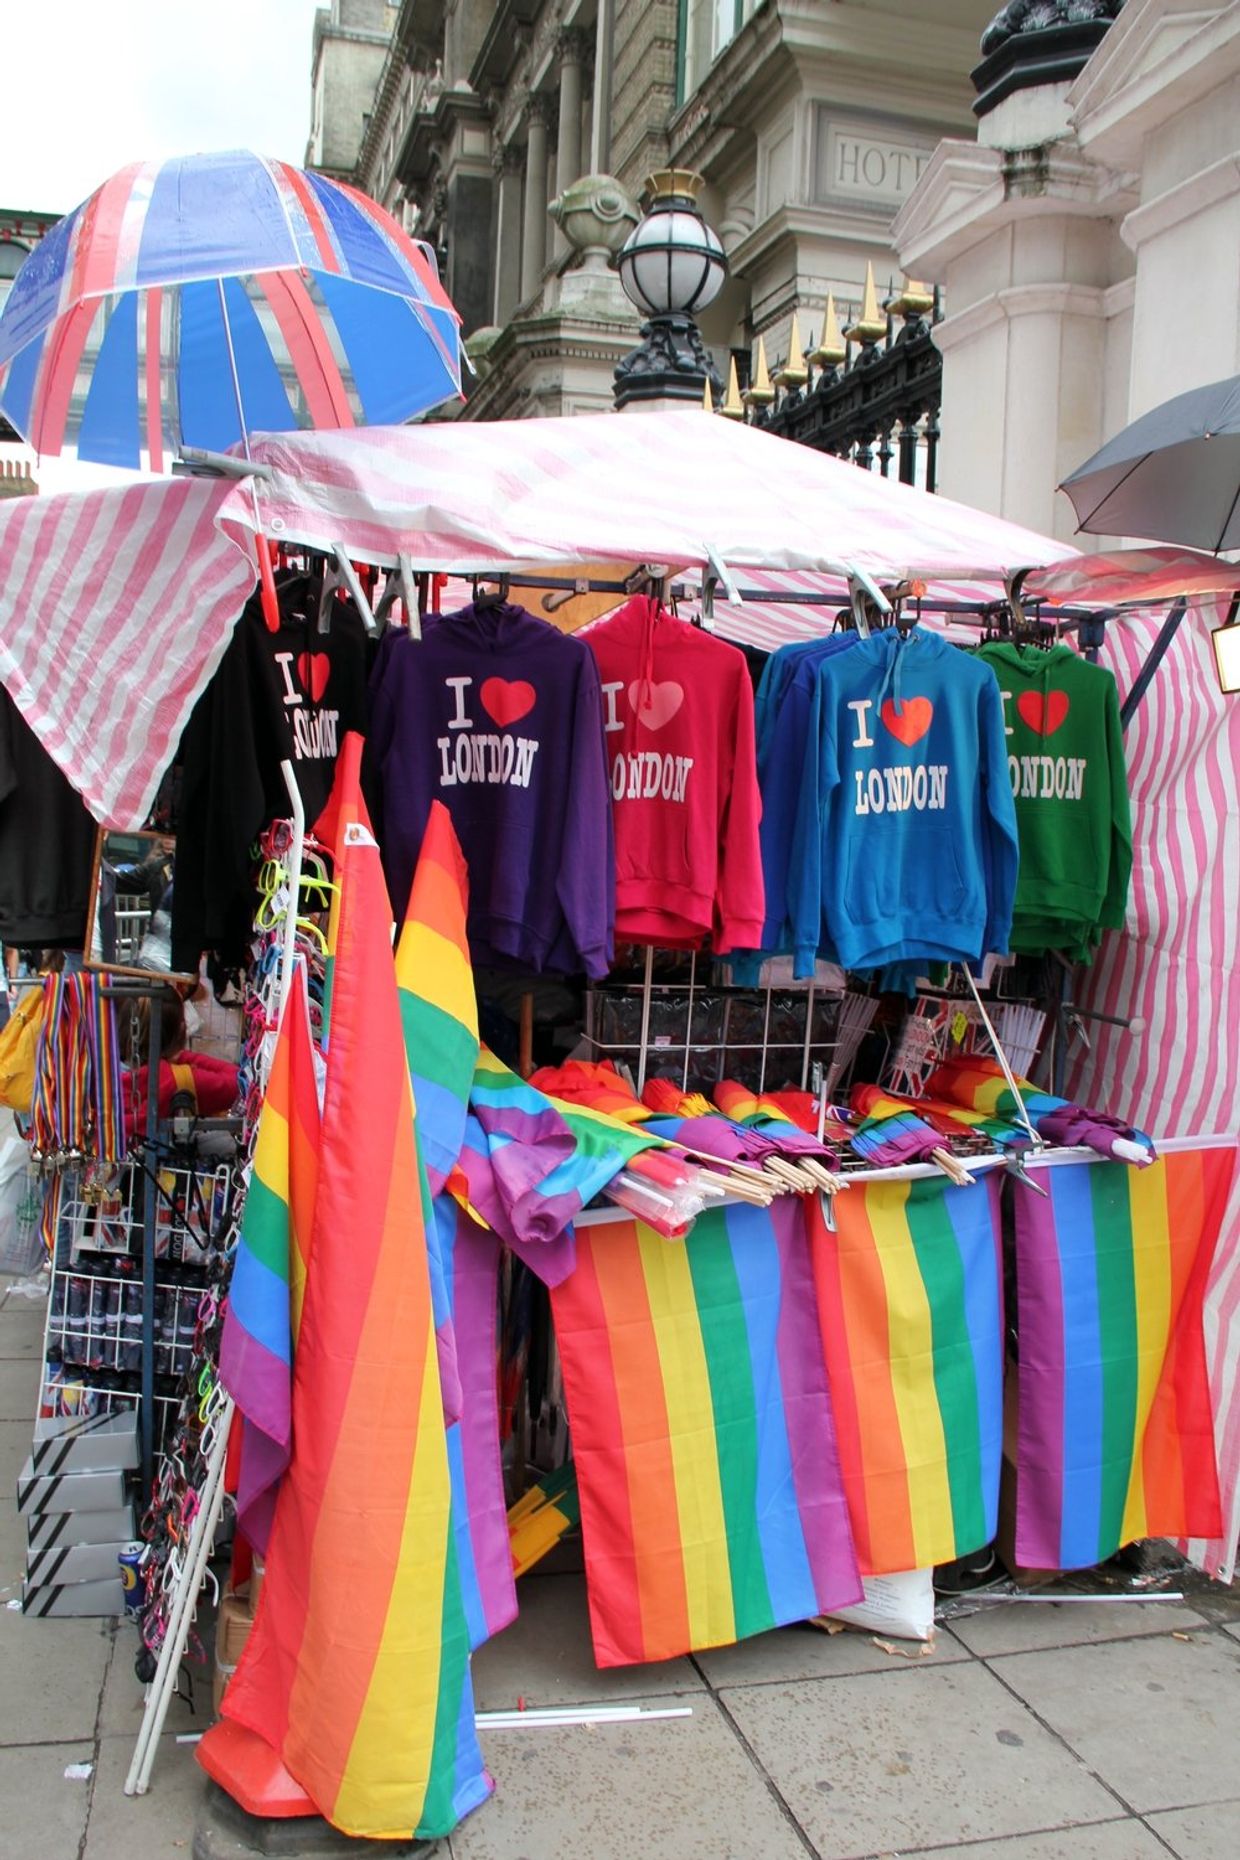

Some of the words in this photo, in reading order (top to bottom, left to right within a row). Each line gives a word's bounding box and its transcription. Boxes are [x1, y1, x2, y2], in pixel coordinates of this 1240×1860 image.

[274, 652, 303, 705] I
[445, 676, 473, 729] I
[601, 681, 625, 732] I
[847, 699, 874, 748] I
[437, 733, 539, 788] LONDON
[609, 752, 694, 803] ONDON
[1008, 755, 1087, 800] ONDON
[855, 765, 948, 815] LONDON
